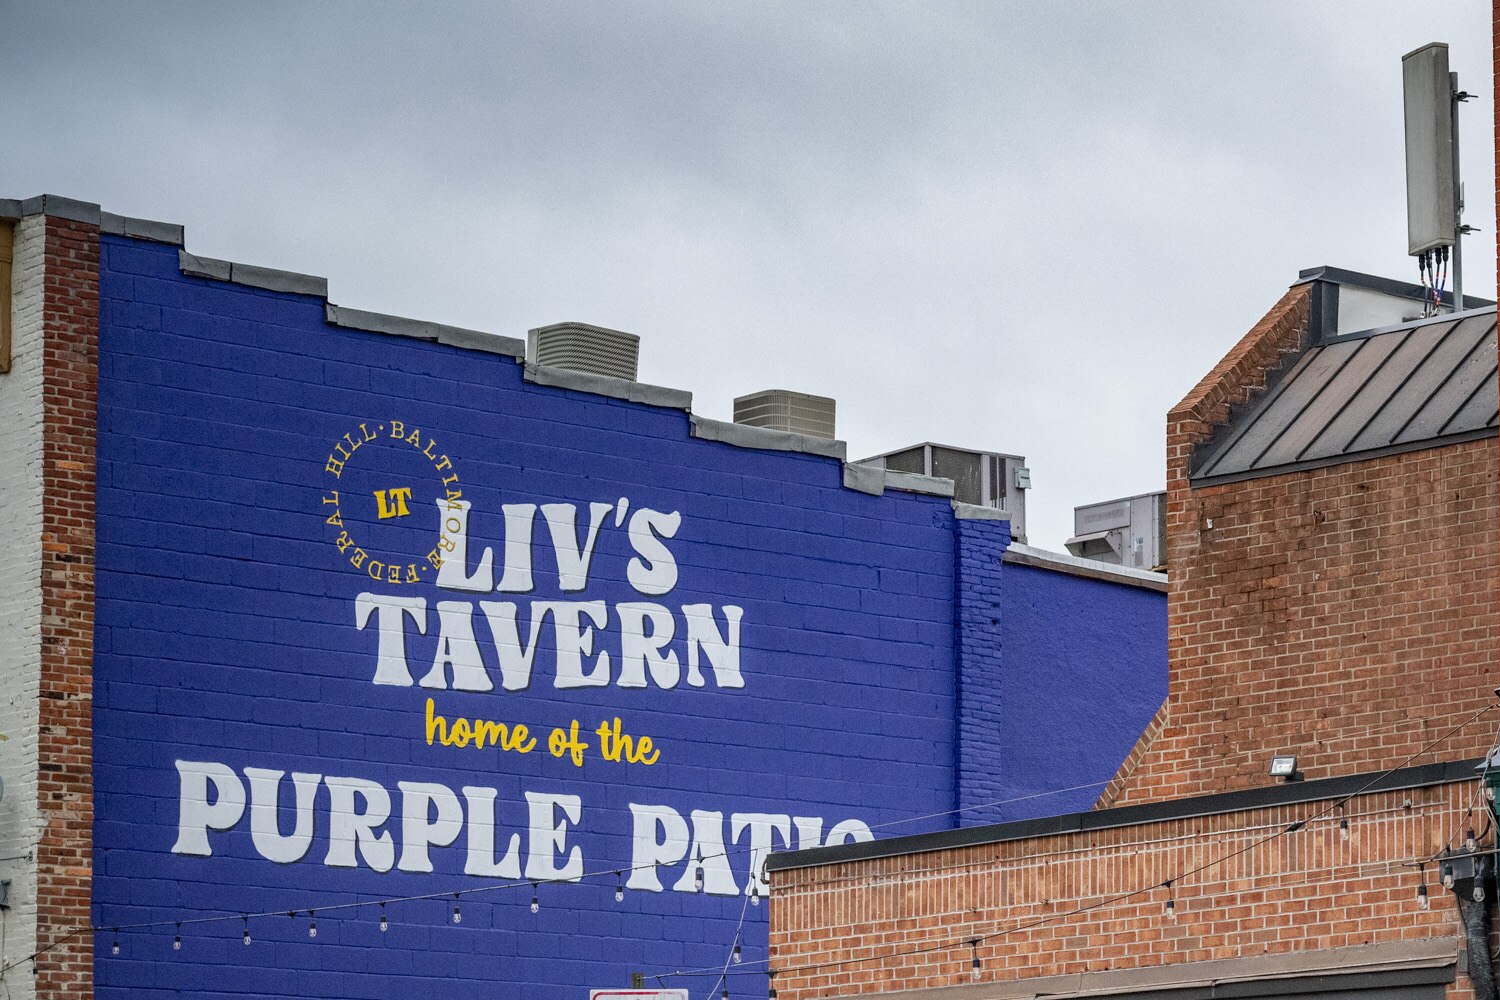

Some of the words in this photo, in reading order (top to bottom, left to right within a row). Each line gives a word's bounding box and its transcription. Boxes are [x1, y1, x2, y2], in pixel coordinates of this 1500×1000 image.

[325, 423, 377, 479] HILL
[390, 421, 463, 570] BALTIMORE
[323, 491, 420, 584] FEDERAL
[373, 487, 412, 519] LT
[435, 497, 682, 596] LIV'S
[355, 592, 745, 692] TAVERN
[425, 698, 537, 754] home
[548, 718, 588, 768] of
[596, 716, 661, 766] the
[170, 759, 585, 883] PURPLE
[626, 803, 876, 897] PAT
